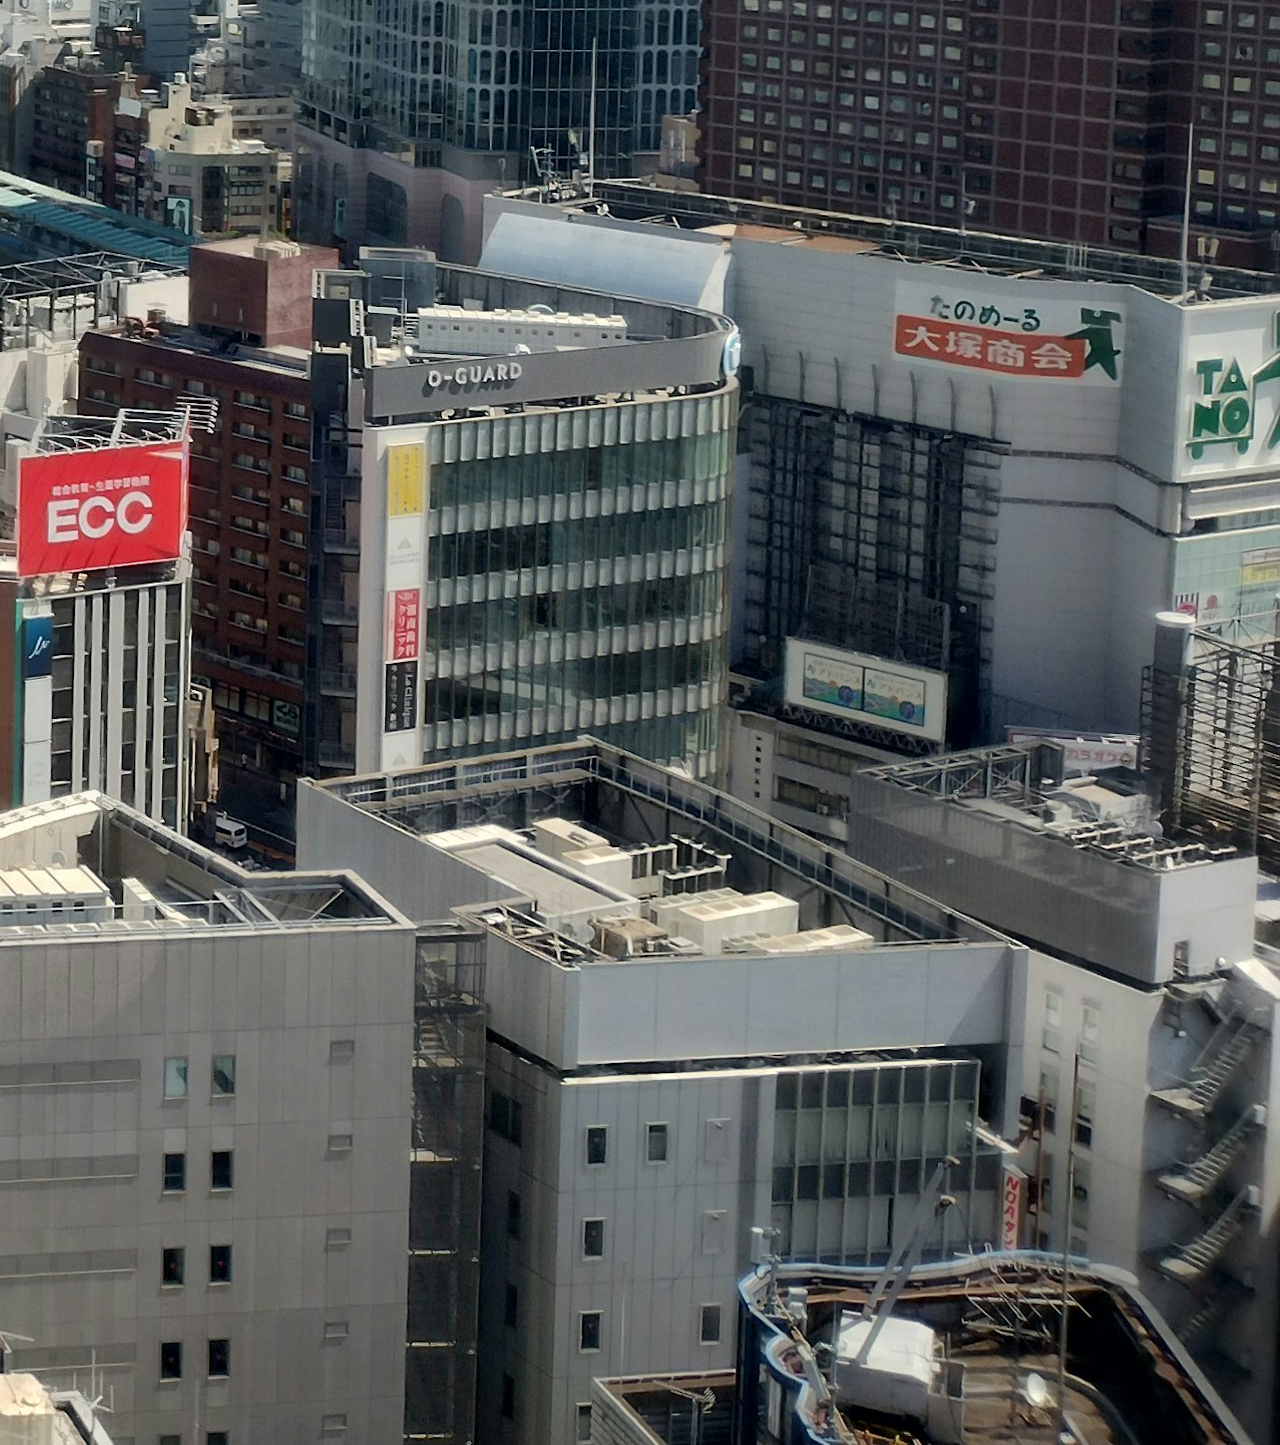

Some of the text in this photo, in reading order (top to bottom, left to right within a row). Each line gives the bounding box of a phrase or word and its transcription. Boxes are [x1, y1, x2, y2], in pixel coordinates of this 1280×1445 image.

[930, 294, 1041, 332] たのめーる
[904, 325, 1073, 370] 大塚商会
[47, 490, 153, 544] ECC
